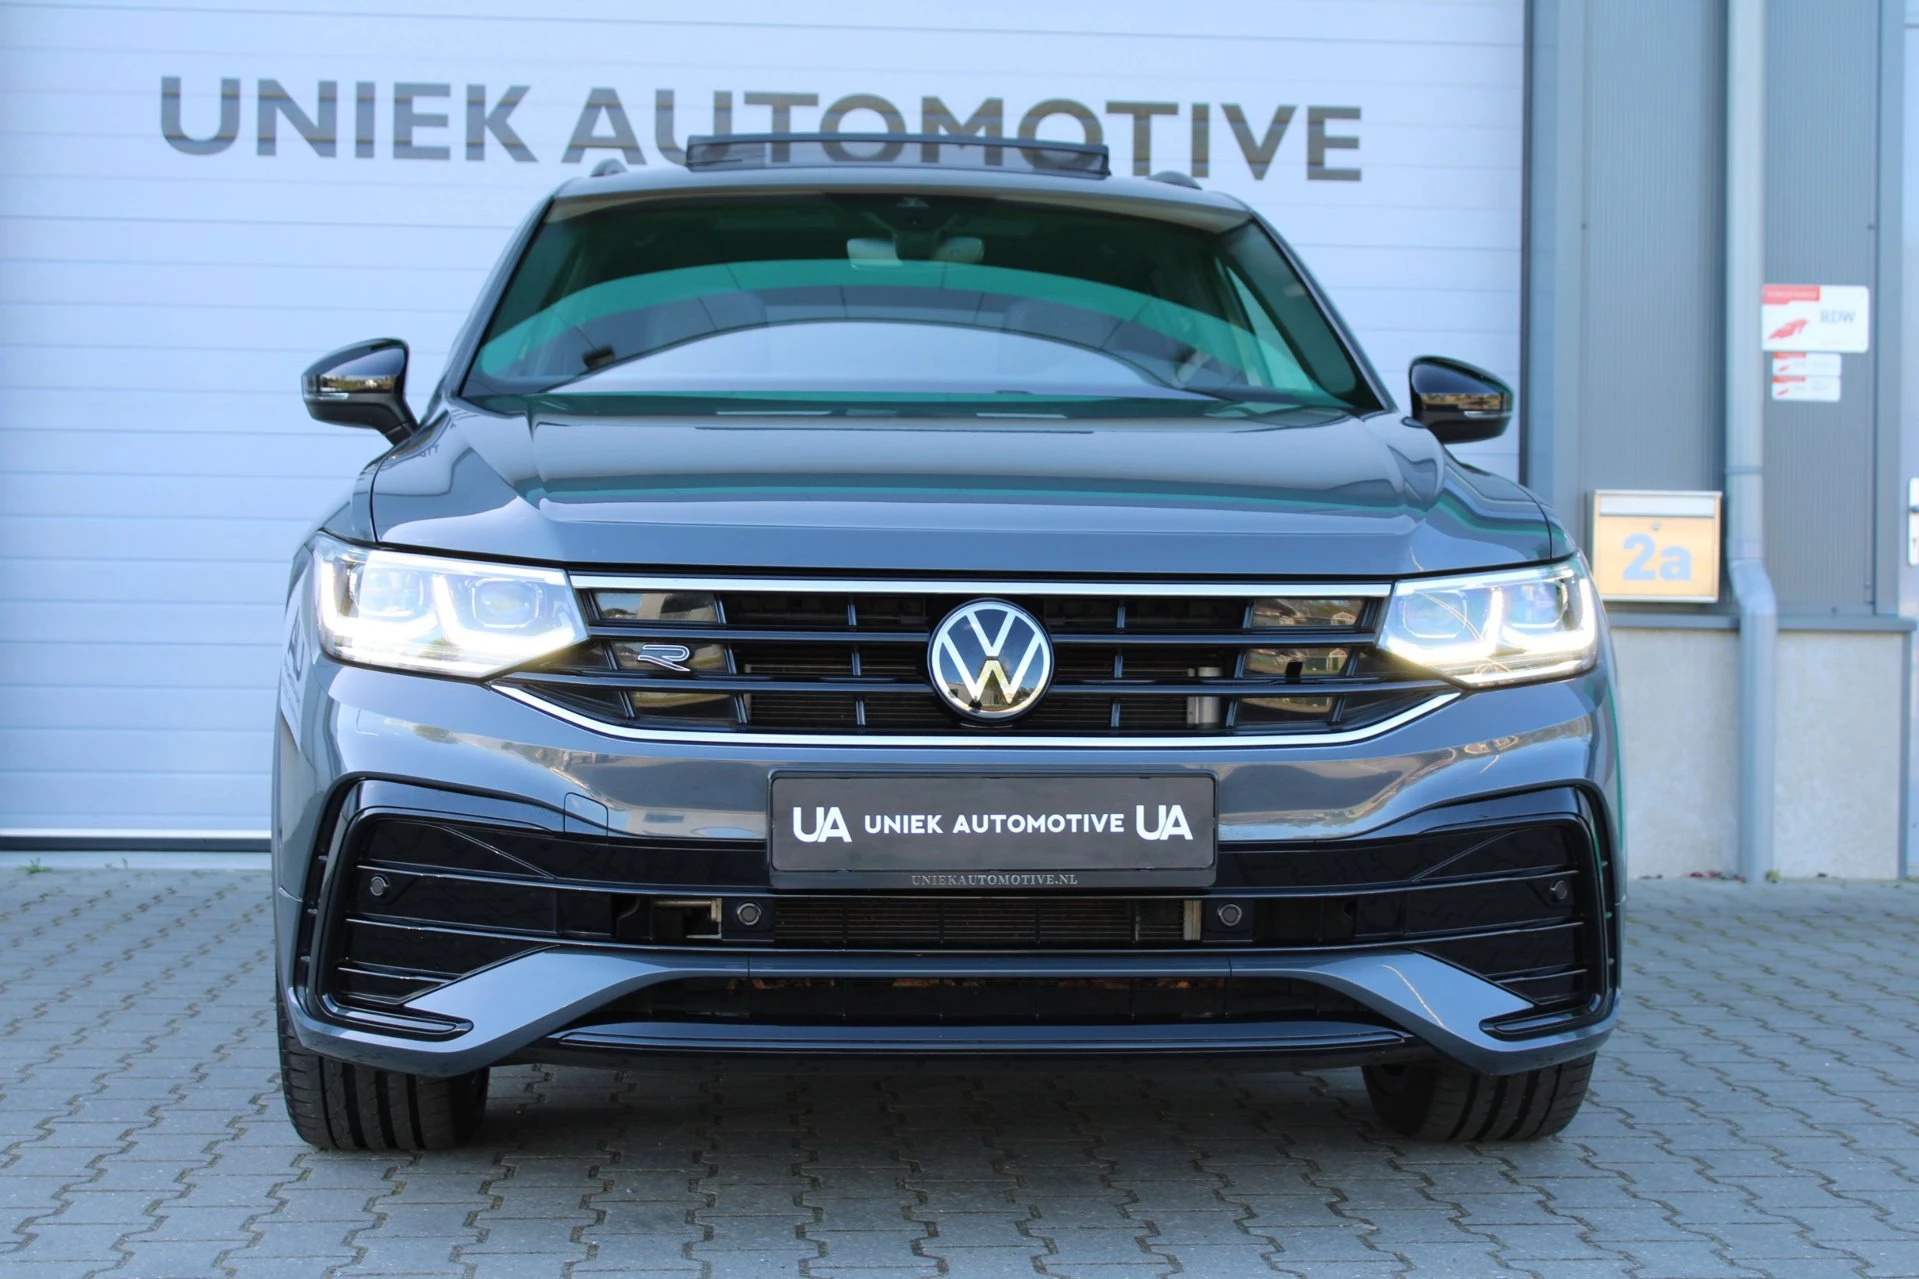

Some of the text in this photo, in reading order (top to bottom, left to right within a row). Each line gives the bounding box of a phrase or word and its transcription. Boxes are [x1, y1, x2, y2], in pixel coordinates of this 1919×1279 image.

[161, 76, 1362, 182] UNIEK AUTOMOTIVE
[1819, 310, 1856, 323] RDW
[1622, 532, 1692, 581] 2a
[792, 804, 1194, 843] UA UNIEK AUTOMOTIVE UA
[911, 873, 1078, 887] UNIEKAUTOMOTIVE.NL
